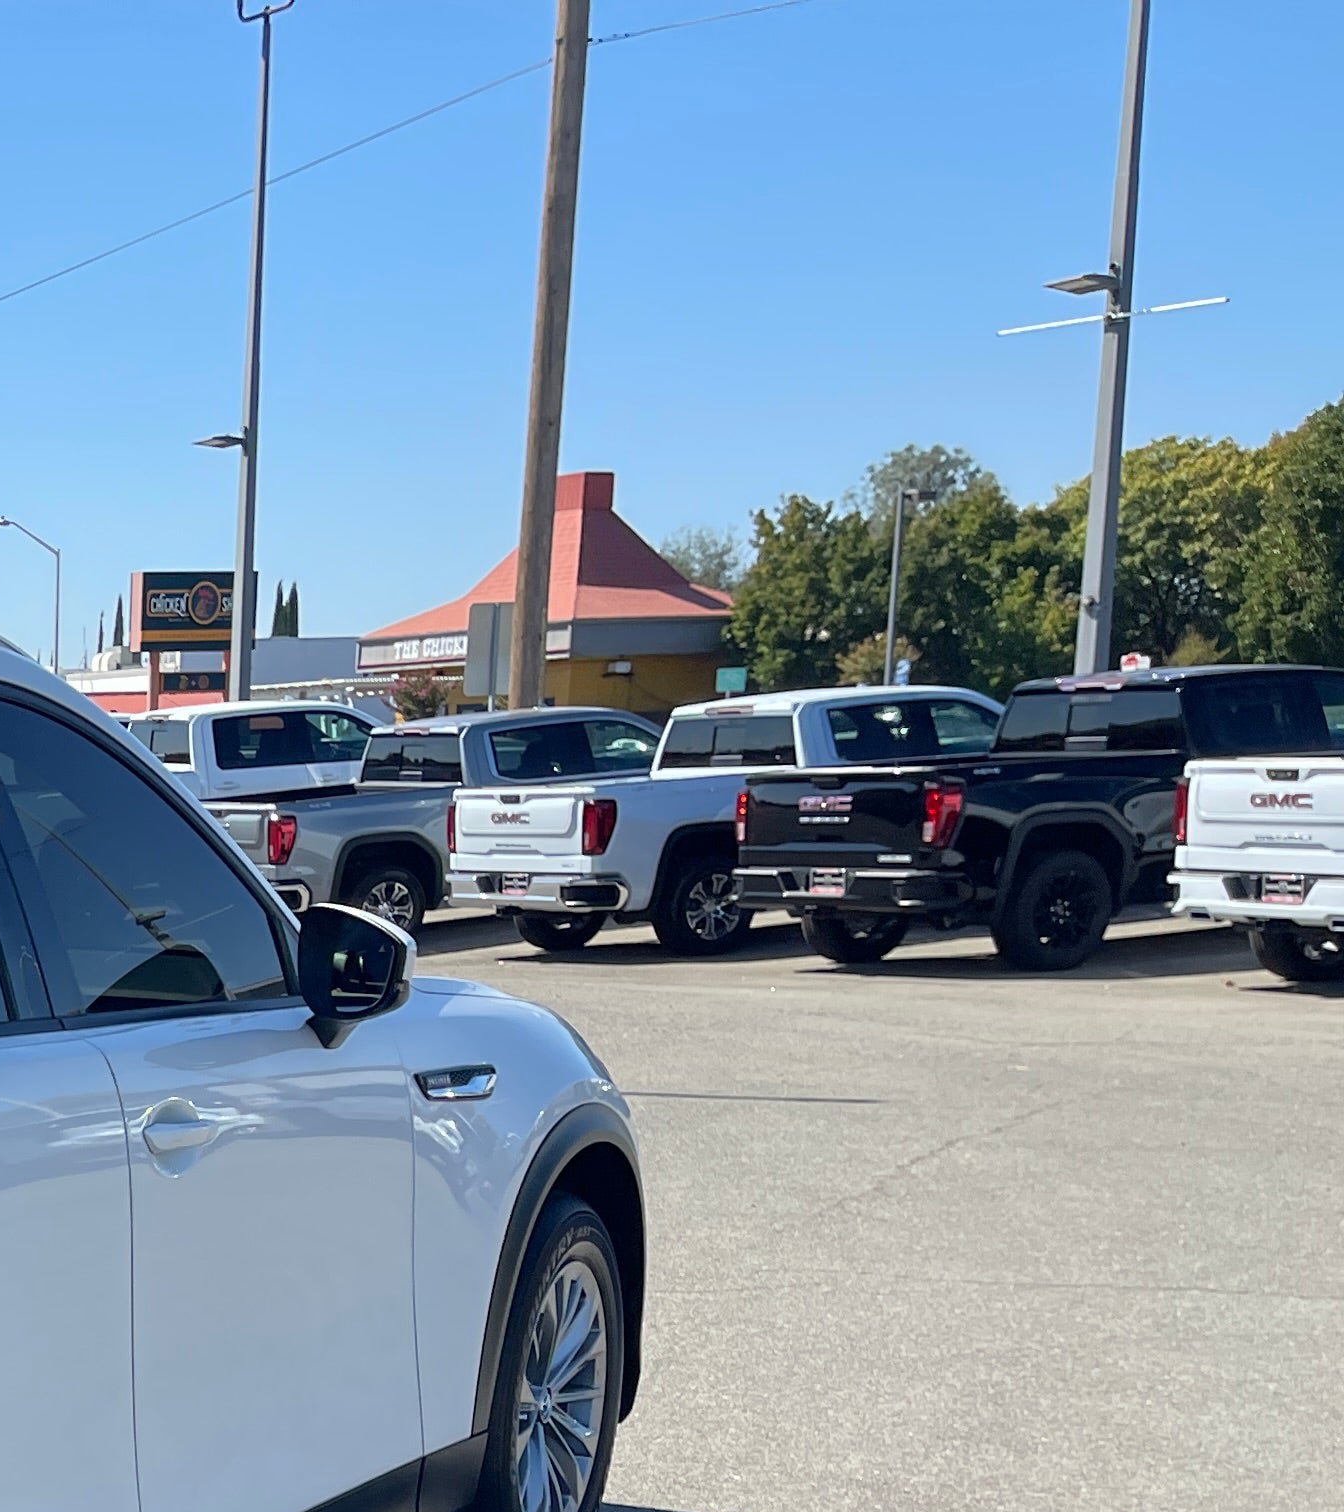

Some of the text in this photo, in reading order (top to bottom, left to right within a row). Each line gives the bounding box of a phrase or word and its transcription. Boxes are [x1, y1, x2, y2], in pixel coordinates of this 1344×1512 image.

[394, 635, 468, 660] THE CHICK
[798, 796, 853, 812] GMC
[1250, 793, 1313, 808] GMC
[491, 812, 530, 824] GMC
